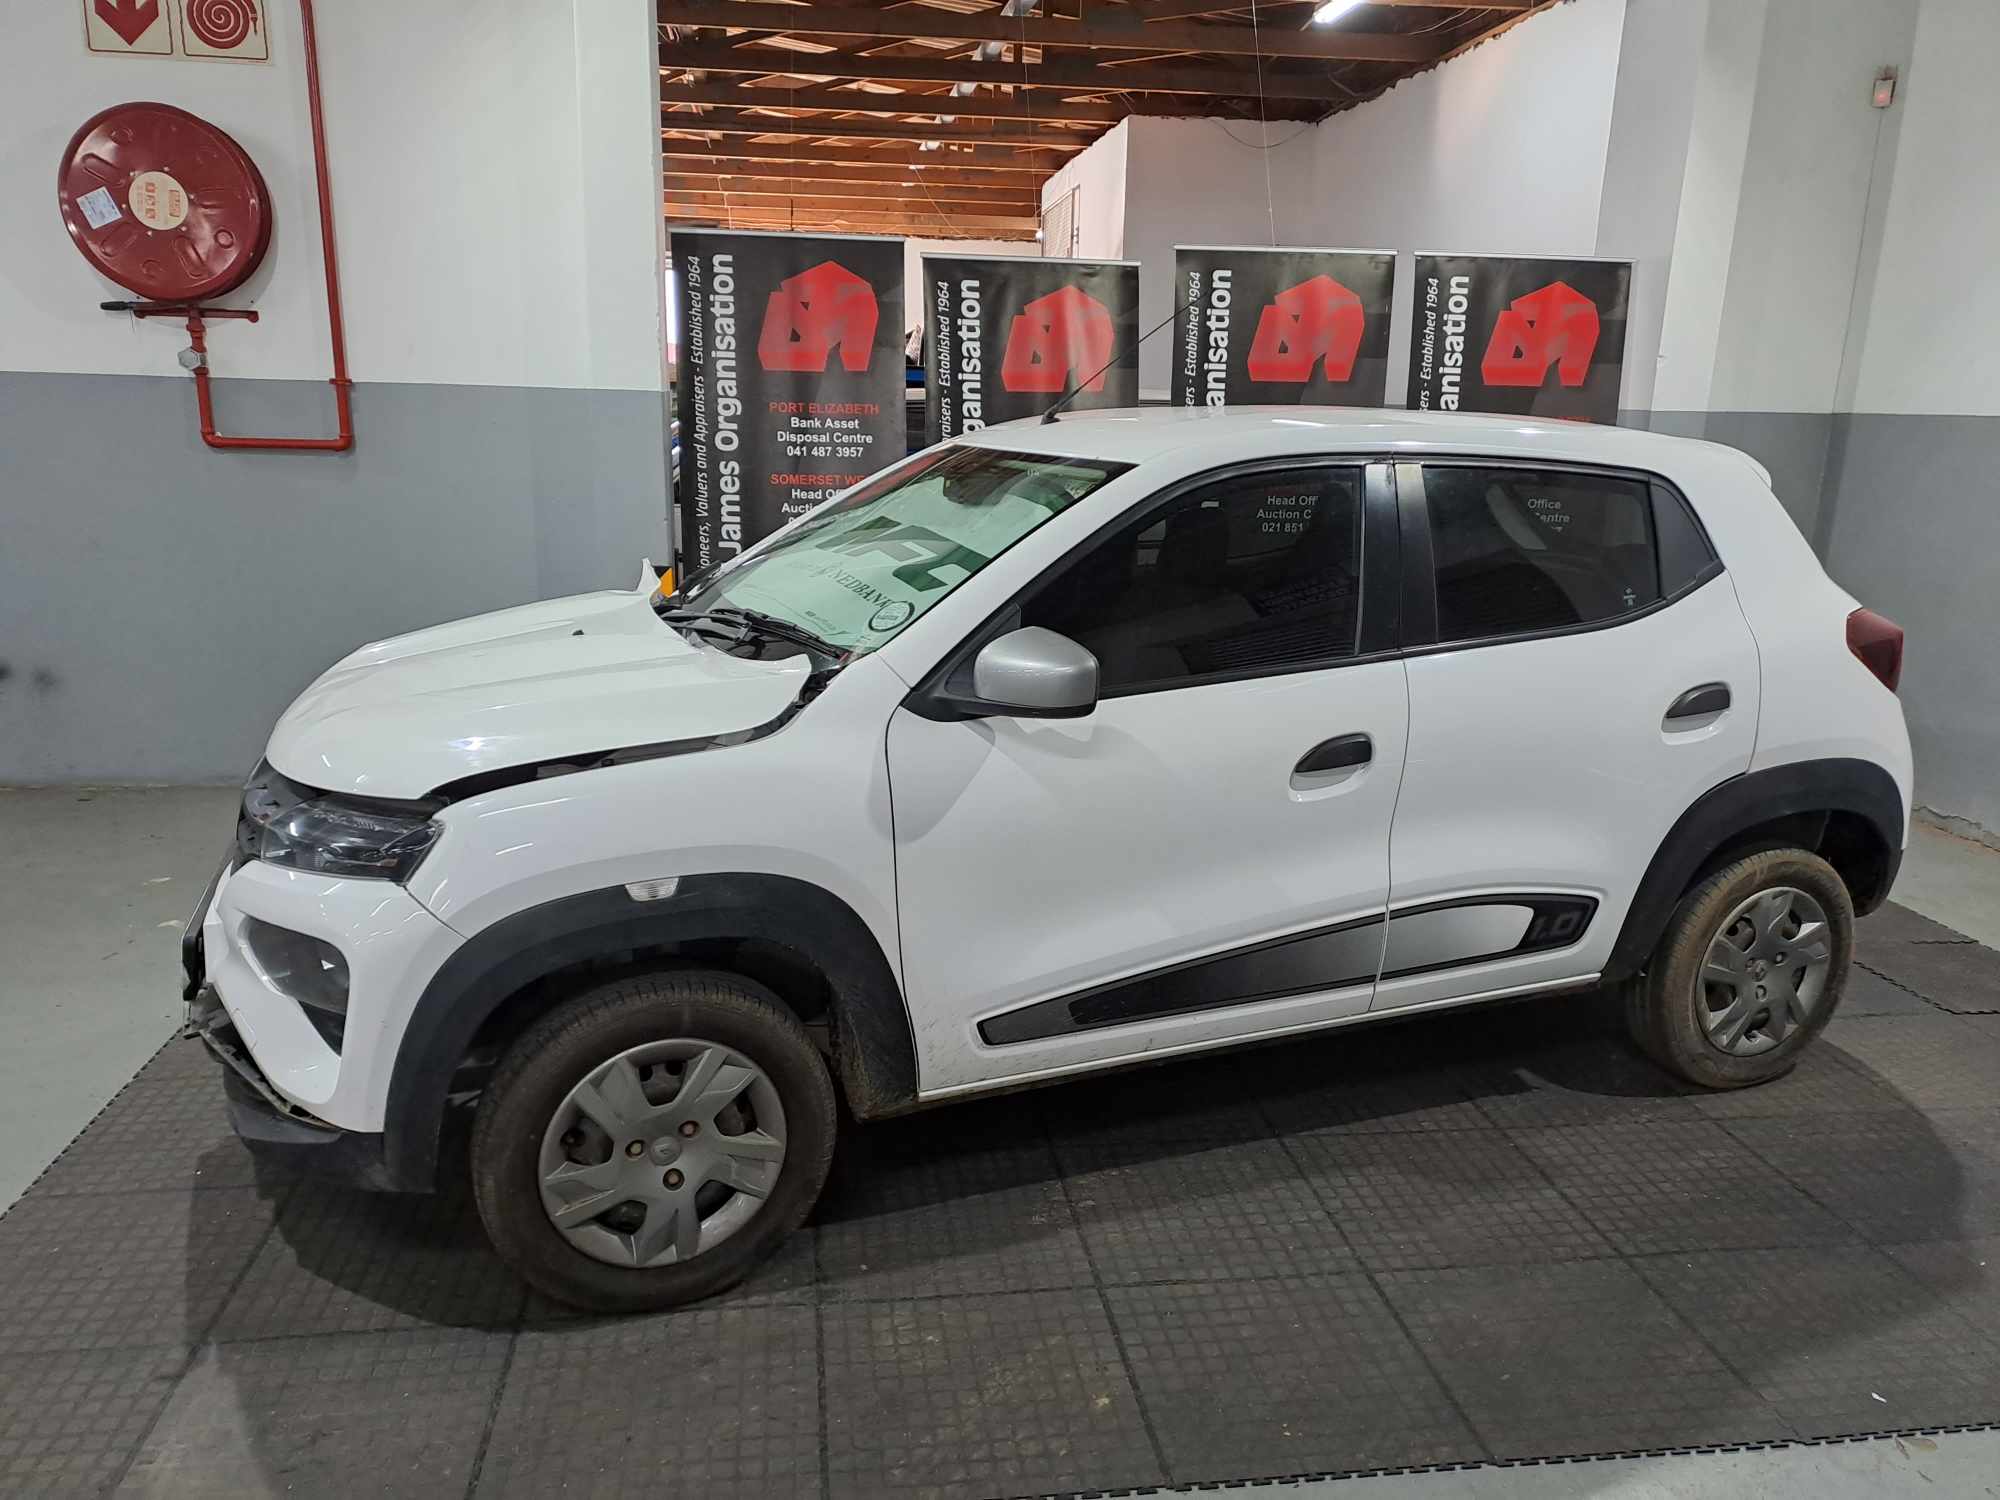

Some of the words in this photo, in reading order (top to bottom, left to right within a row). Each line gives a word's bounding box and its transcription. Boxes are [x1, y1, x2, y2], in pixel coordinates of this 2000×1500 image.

[687, 255, 701, 287] 1964
[937, 281, 950, 312] 1964
[1188, 271, 1201, 303] 1964
[1426, 278, 1439, 307] 1964
[688, 291, 703, 364] Established
[1184, 306, 1199, 376] Established
[709, 254, 742, 452] Organisation
[937, 315, 951, 386] Established
[957, 279, 986, 434] ganisation
[1420, 311, 1436, 380] Established
[1439, 276, 1469, 410] anisation
[692, 375, 709, 442] Appraisers
[769, 402, 804, 414] PORT
[808, 403, 880, 415] ELIZABETH
[1185, 387, 1195, 407] ers
[777, 431, 830, 444] Disposal
[833, 432, 873, 444] Centre
[790, 417, 821, 428] Bank
[825, 418, 860, 429] Asset
[693, 443, 707, 469] and
[786, 446, 807, 456] 041
[811, 447, 832, 457] 487
[836, 447, 864, 457] 3957
[695, 471, 709, 517] Valuers
[770, 474, 841, 485] SOMERSET
[791, 489, 822, 499] Head
[718, 460, 742, 555] James
[1256, 509, 1300, 519] Auction
[1303, 509, 1312, 519] C
[1267, 495, 1296, 505] Head
[1528, 498, 1561, 509] Office
[1262, 522, 1281, 532] 021
[1536, 513, 1570, 522] entre
